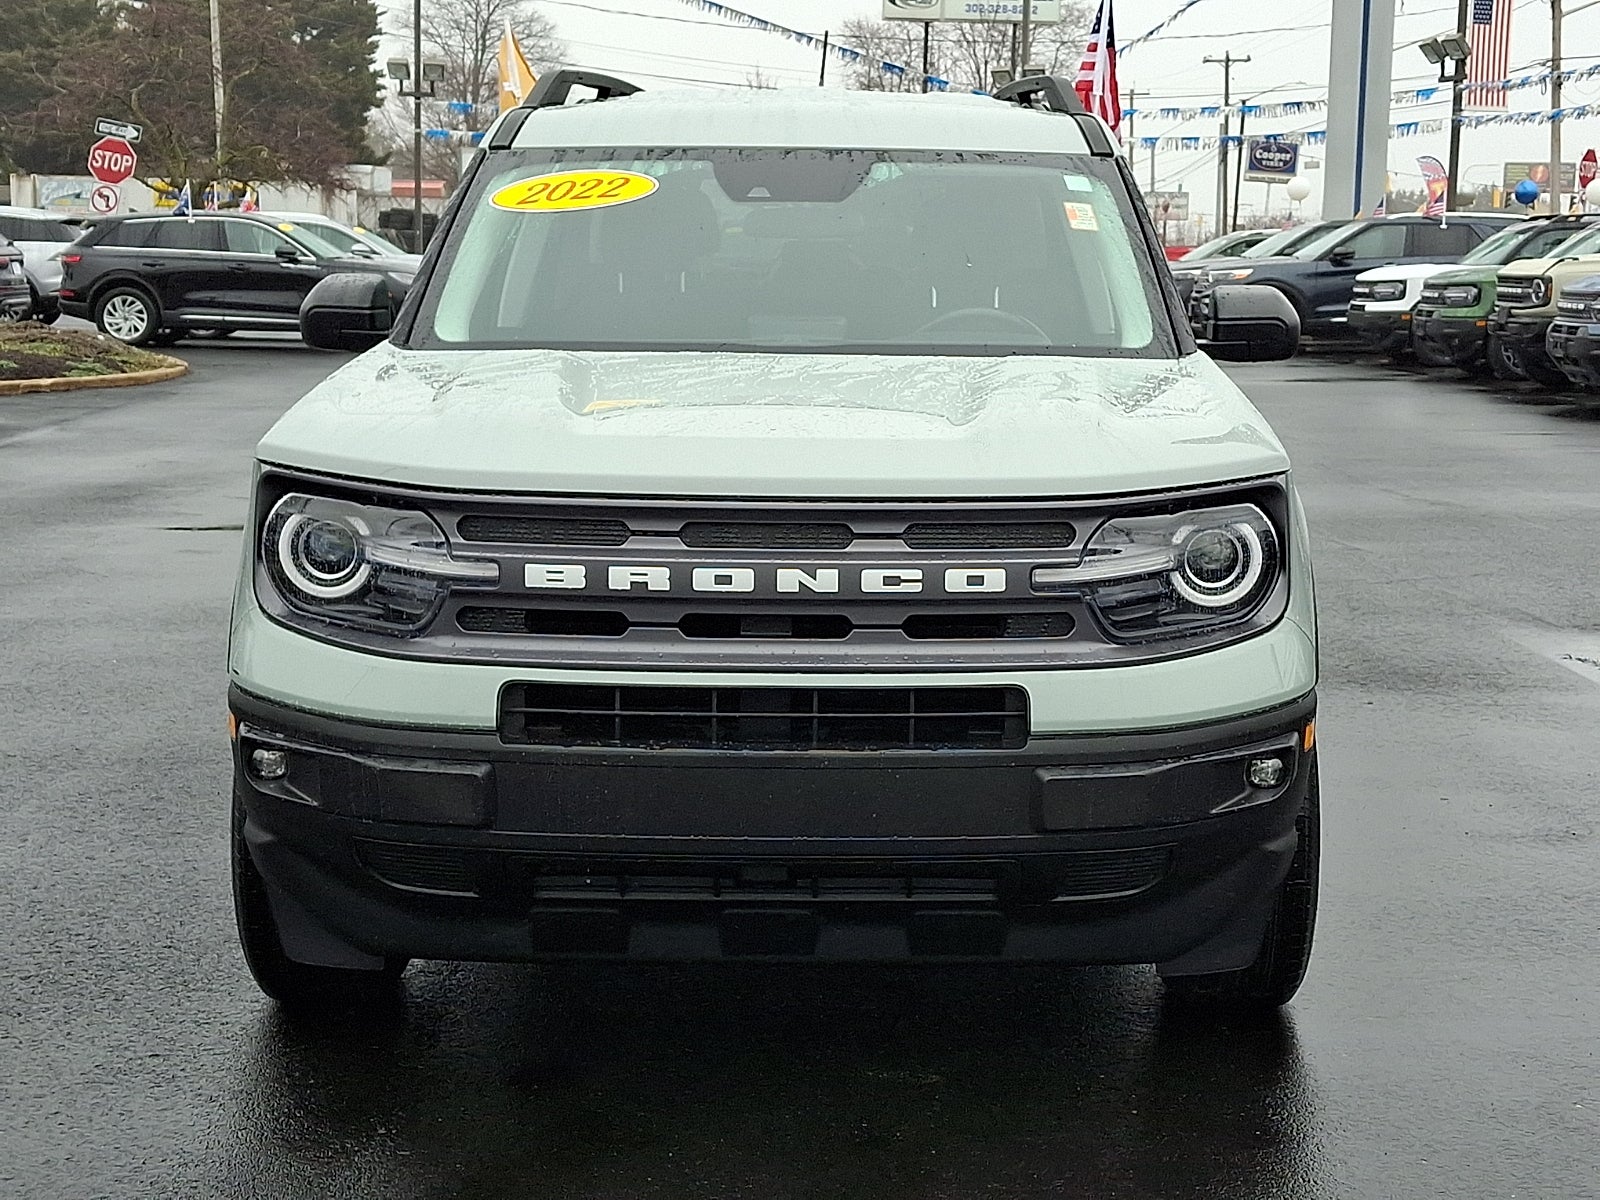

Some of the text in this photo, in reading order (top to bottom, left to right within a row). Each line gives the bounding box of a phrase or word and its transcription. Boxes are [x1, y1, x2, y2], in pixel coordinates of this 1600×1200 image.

[965, 4, 1038, 15] 302-328-822
[92, 149, 132, 173] STOP
[1255, 149, 1292, 162] Cooper
[516, 177, 631, 205] 2022
[524, 563, 1007, 593] BRONCO
